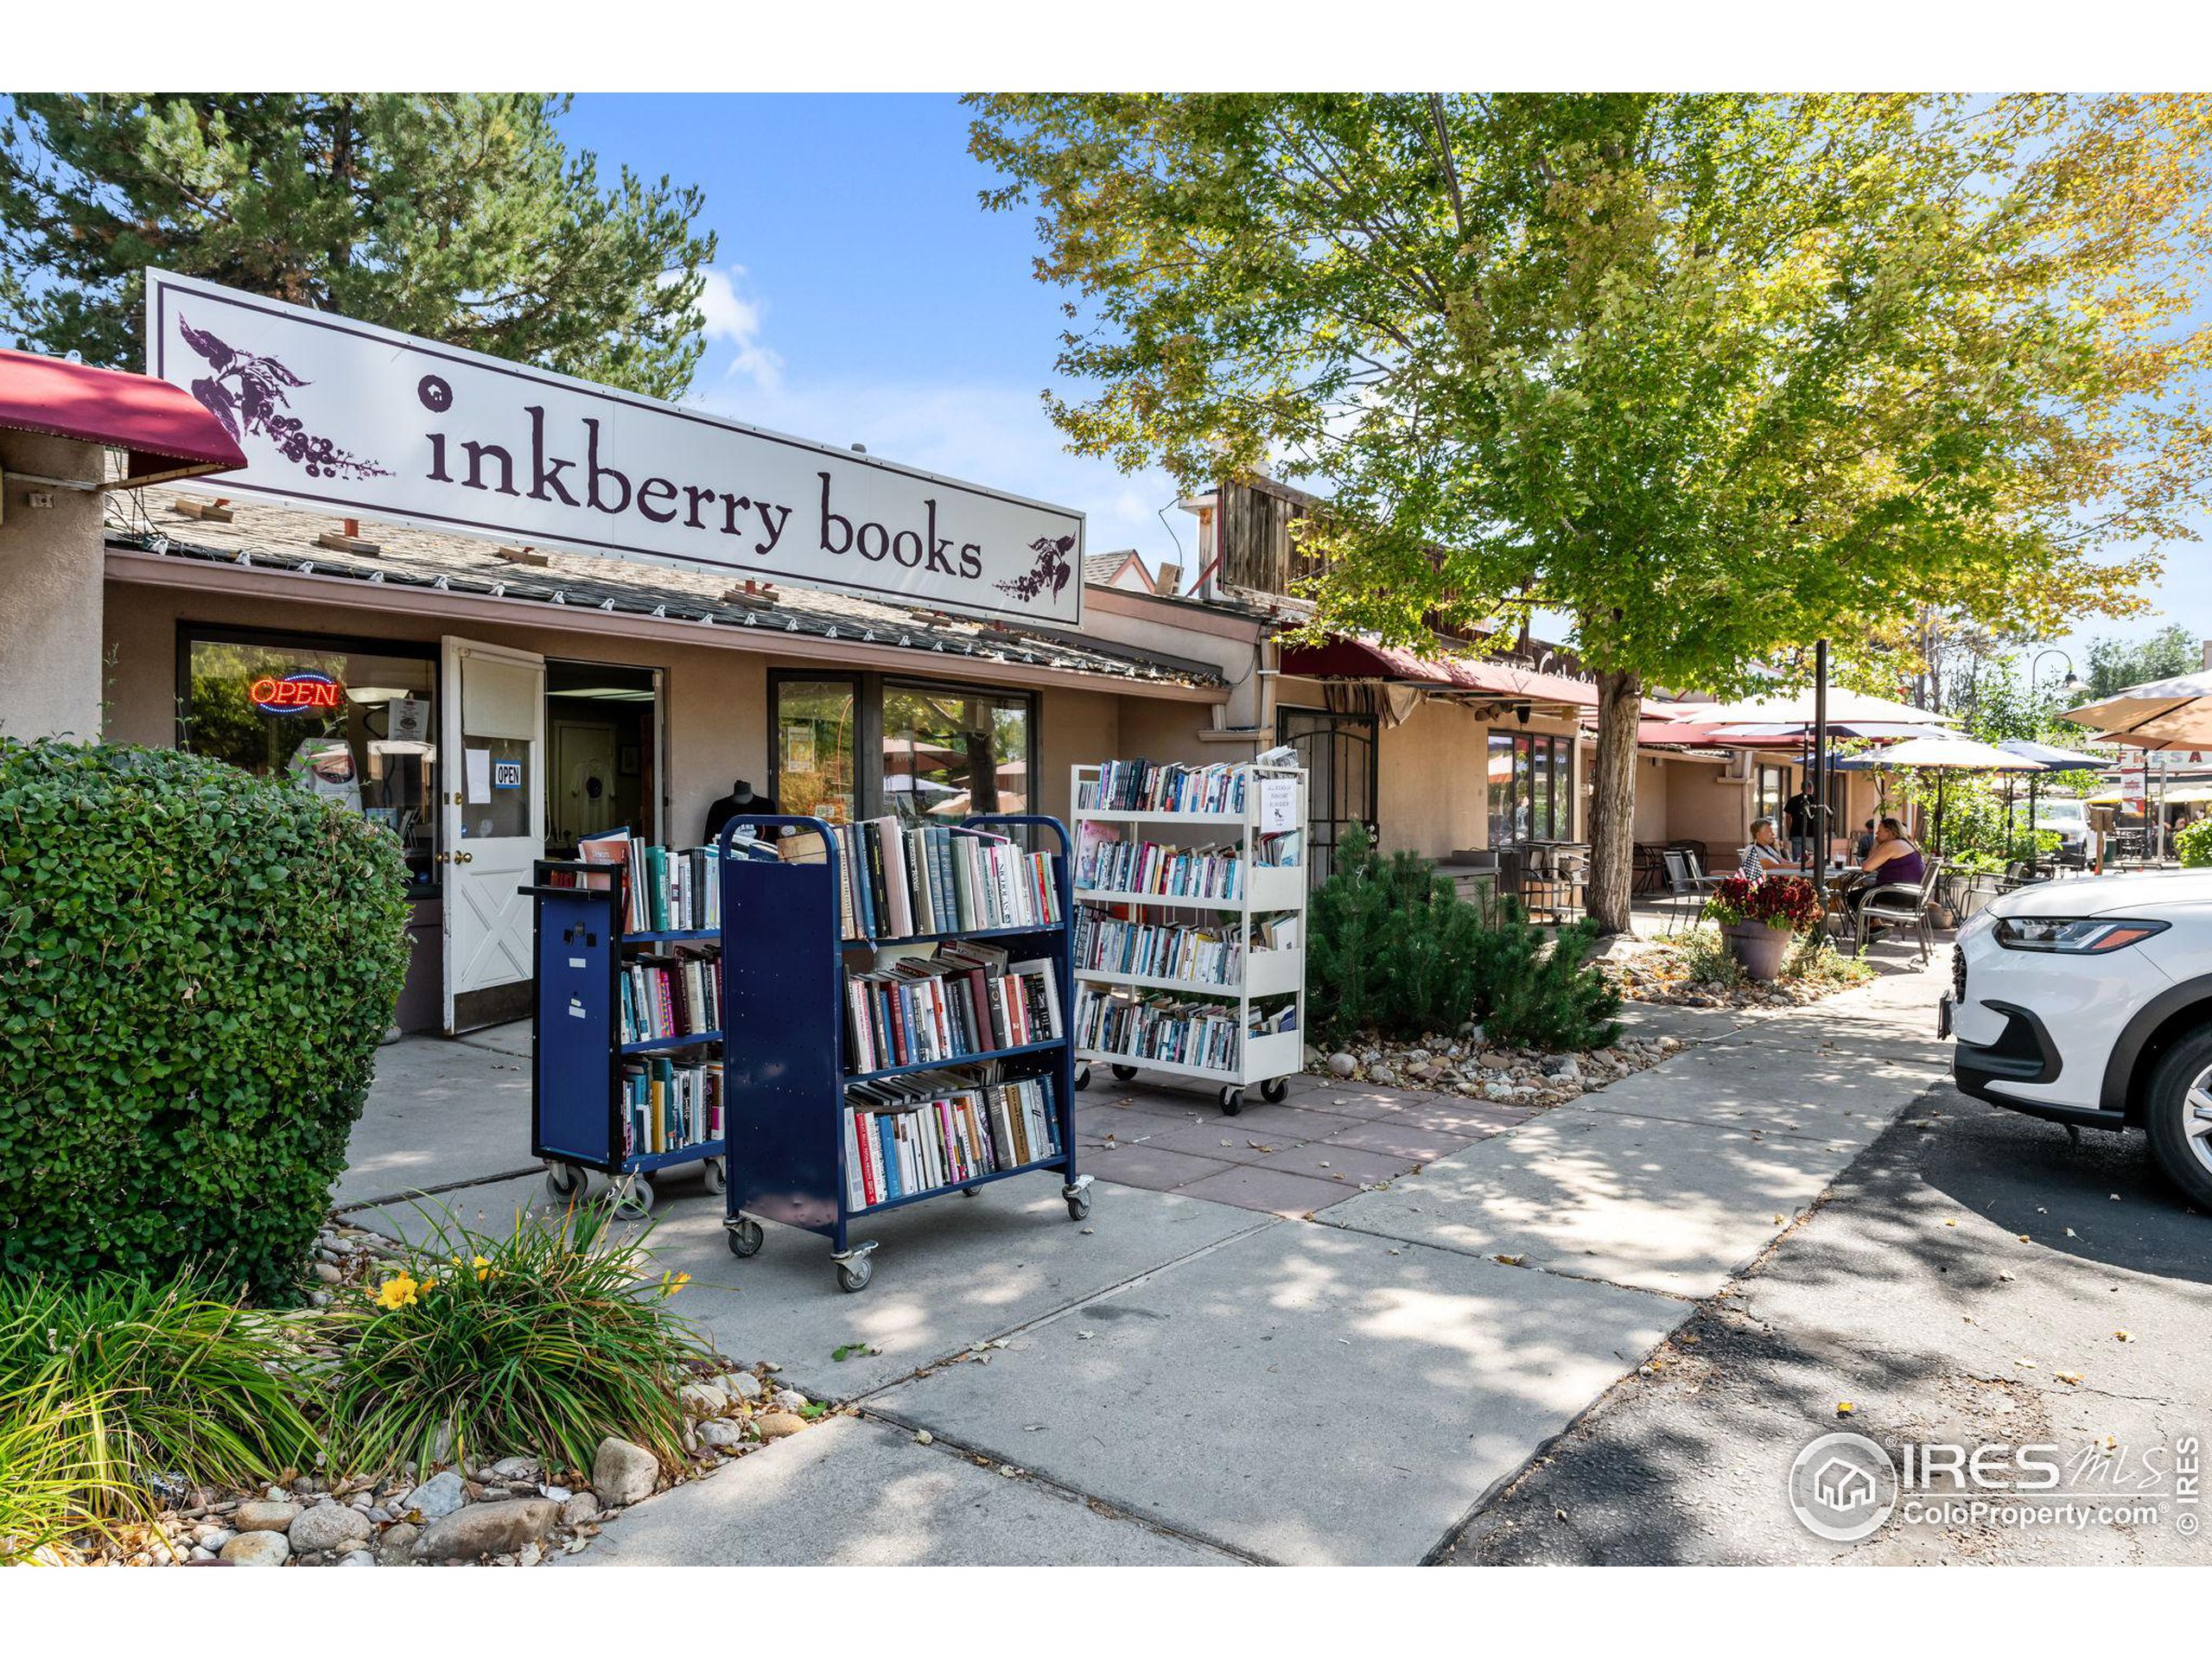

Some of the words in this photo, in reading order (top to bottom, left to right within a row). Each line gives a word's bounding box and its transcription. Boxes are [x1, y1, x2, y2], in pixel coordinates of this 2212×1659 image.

[418, 375, 793, 555] inkberry
[817, 472, 982, 579] books
[251, 679, 338, 706] OPEN
[498, 766, 519, 784] OPEN
